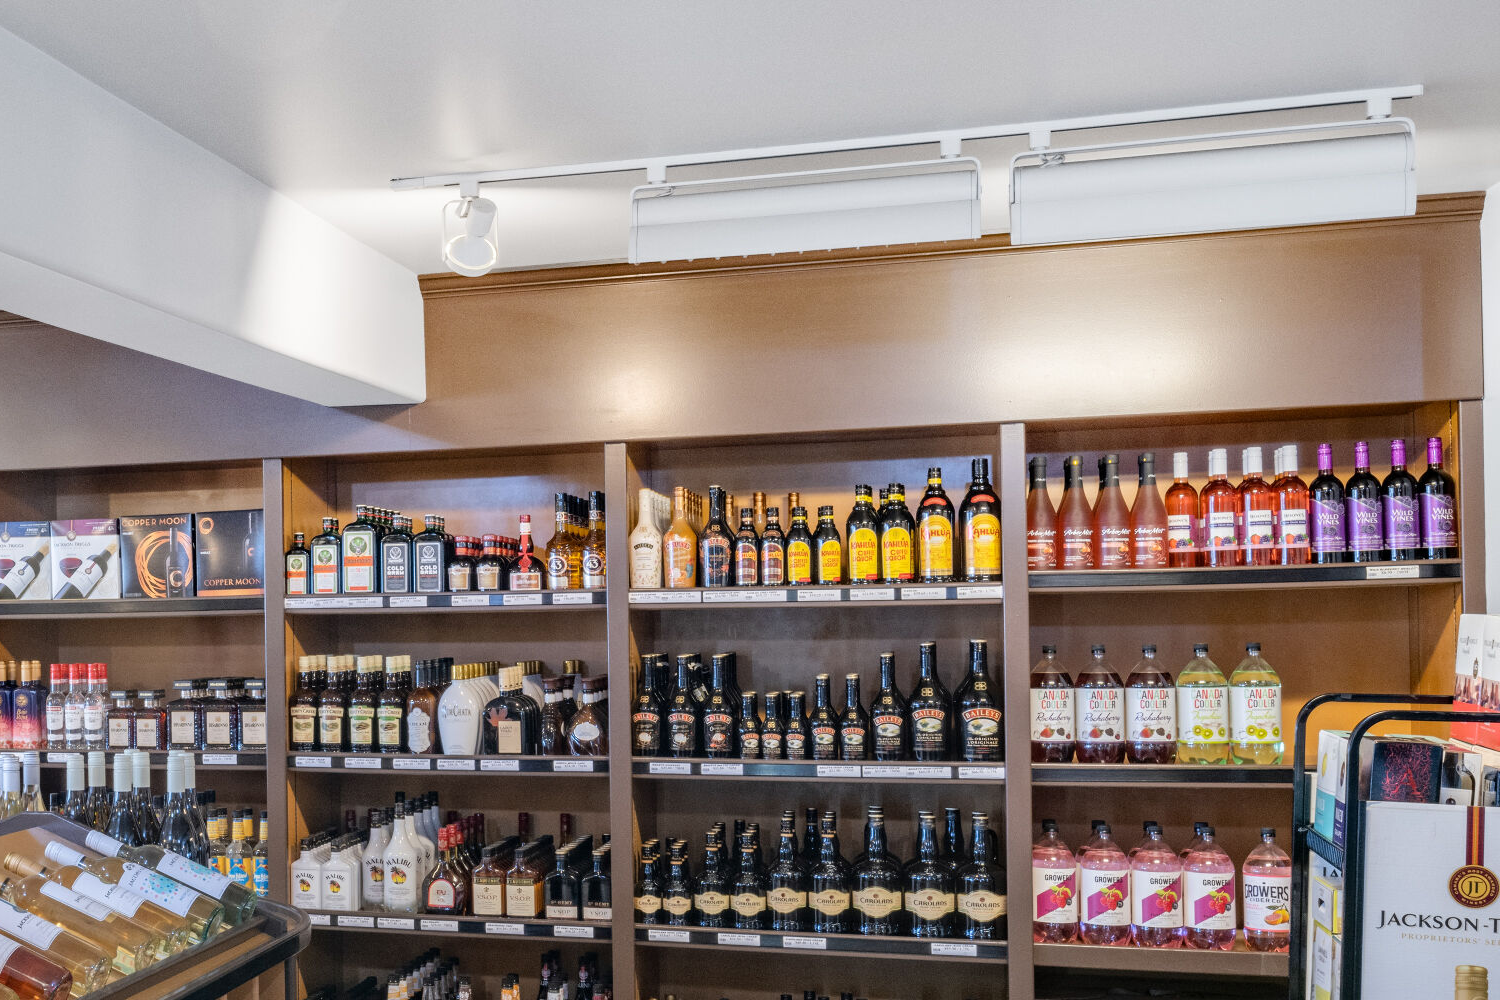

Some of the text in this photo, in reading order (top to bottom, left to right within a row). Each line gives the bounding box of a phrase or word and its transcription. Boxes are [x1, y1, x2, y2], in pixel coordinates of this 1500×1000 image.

[1432, 507, 1453, 515] WILD
[122, 517, 187, 527] COPPER MOON
[920, 526, 951, 541] KAHLÚA
[204, 577, 262, 587] COPPER MOON
[1038, 689, 1069, 700] CANADA
[1086, 689, 1118, 700] CANADA
[1137, 688, 1170, 700] CANADA
[1191, 688, 1223, 699] CANADA
[1244, 688, 1277, 699] CANADA
[1041, 700, 1067, 709] COOLER
[1089, 700, 1116, 709] COOLER
[1140, 700, 1167, 709] COOLER
[1194, 699, 1221, 709] COOLER
[1248, 699, 1275, 709] COOLER
[634, 713, 659, 722] BAILEYS
[669, 713, 694, 722] BAILEYS
[705, 714, 732, 723] BAILEYS
[914, 710, 945, 720] BAILEYS
[964, 708, 1001, 721] BAILEYS
[1035, 712, 1071, 723] Rockaberry
[875, 716, 902, 725] BAILEYS
[386, 857, 413, 868] MALIBU
[295, 872, 315, 880] MALIBU
[325, 873, 346, 882] MALIBU
[1244, 883, 1289, 902] GROWERS
[1468, 880, 1484, 896] JT
[770, 895, 799, 903] CAROLANS
[913, 899, 947, 907] CAROLANS
